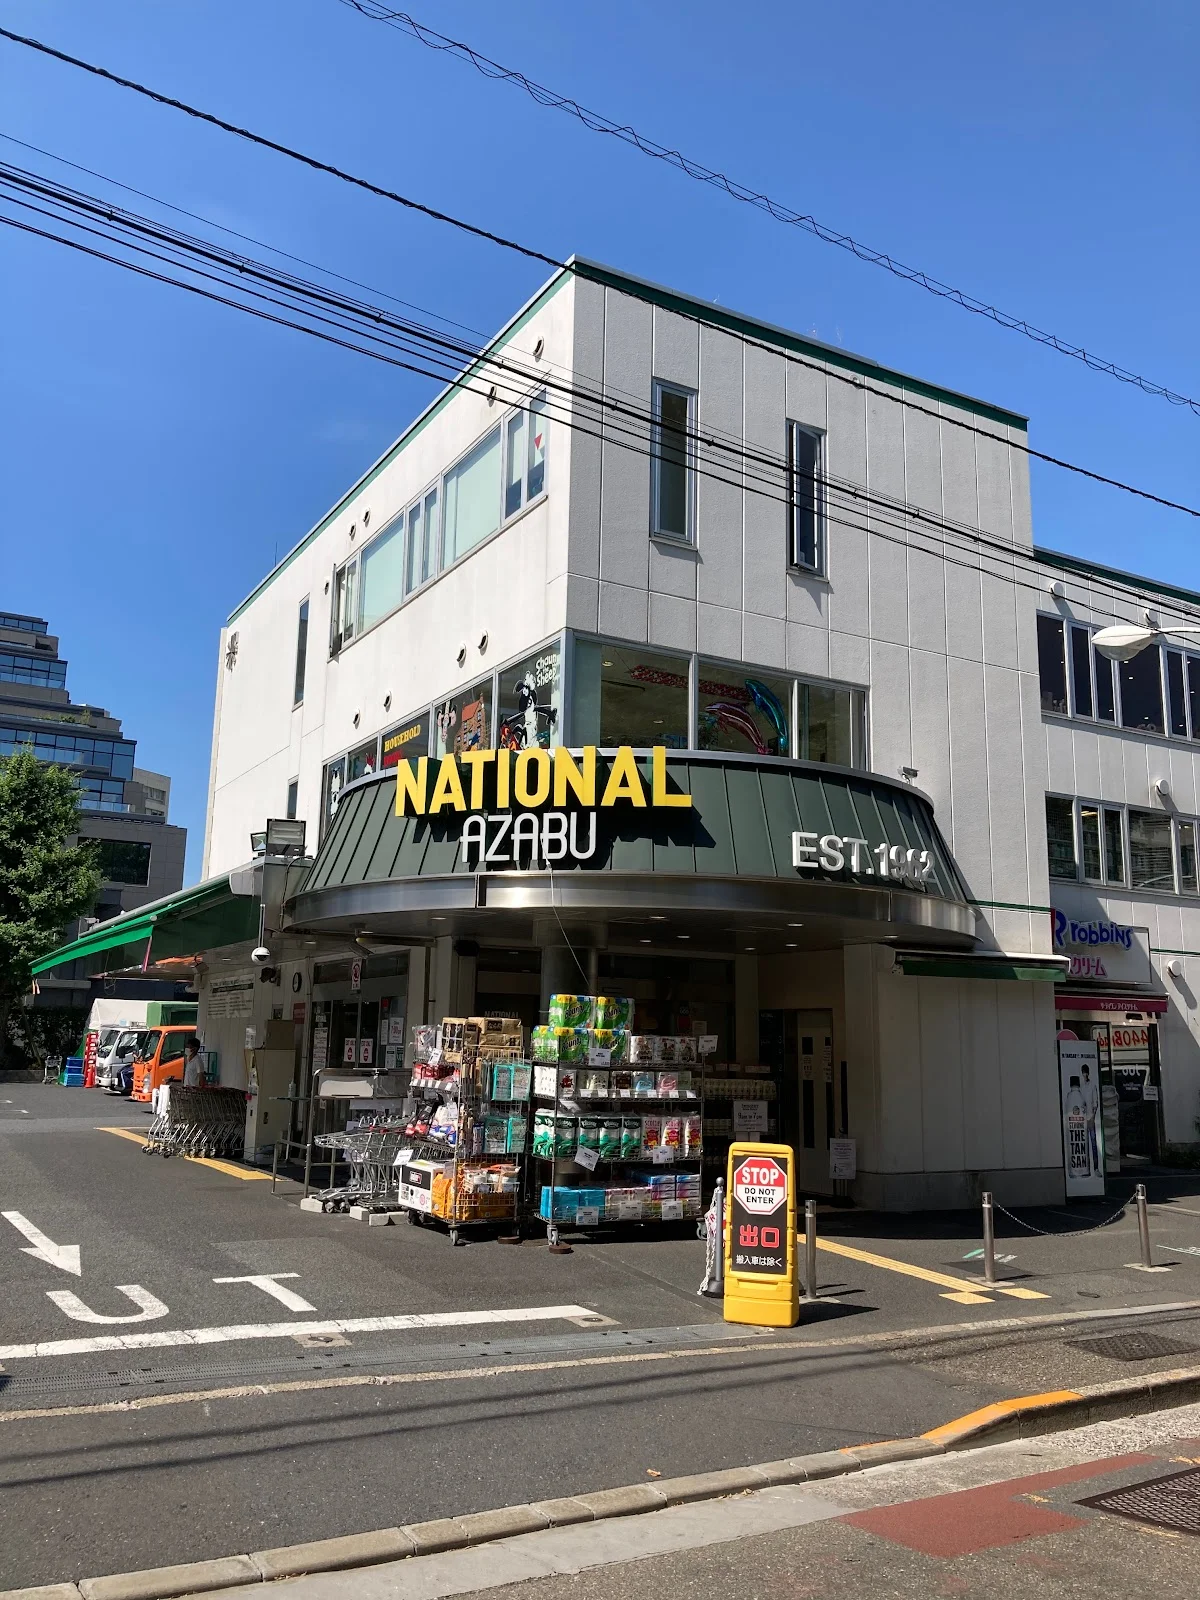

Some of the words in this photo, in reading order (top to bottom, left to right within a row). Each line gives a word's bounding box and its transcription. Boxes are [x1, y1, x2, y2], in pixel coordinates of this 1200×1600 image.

[536, 654, 557, 675] Shaun
[537, 667, 557, 687] Sheep
[384, 724, 421, 752] HOUSEHOLD
[395, 745, 692, 817] NATIONAL
[460, 811, 597, 863] AZABU
[1070, 1130, 1085, 1141] THE
[1070, 1143, 1086, 1154] TAN
[1071, 1156, 1087, 1168] SAN
[742, 1166, 779, 1185] STOP
[744, 1187, 756, 1195] DO
[758, 1188, 776, 1196] NOT
[746, 1196, 774, 1204] ENTER
[739, 1224, 780, 1248] 出口
[735, 1254, 782, 1267] 搬入車は除く
